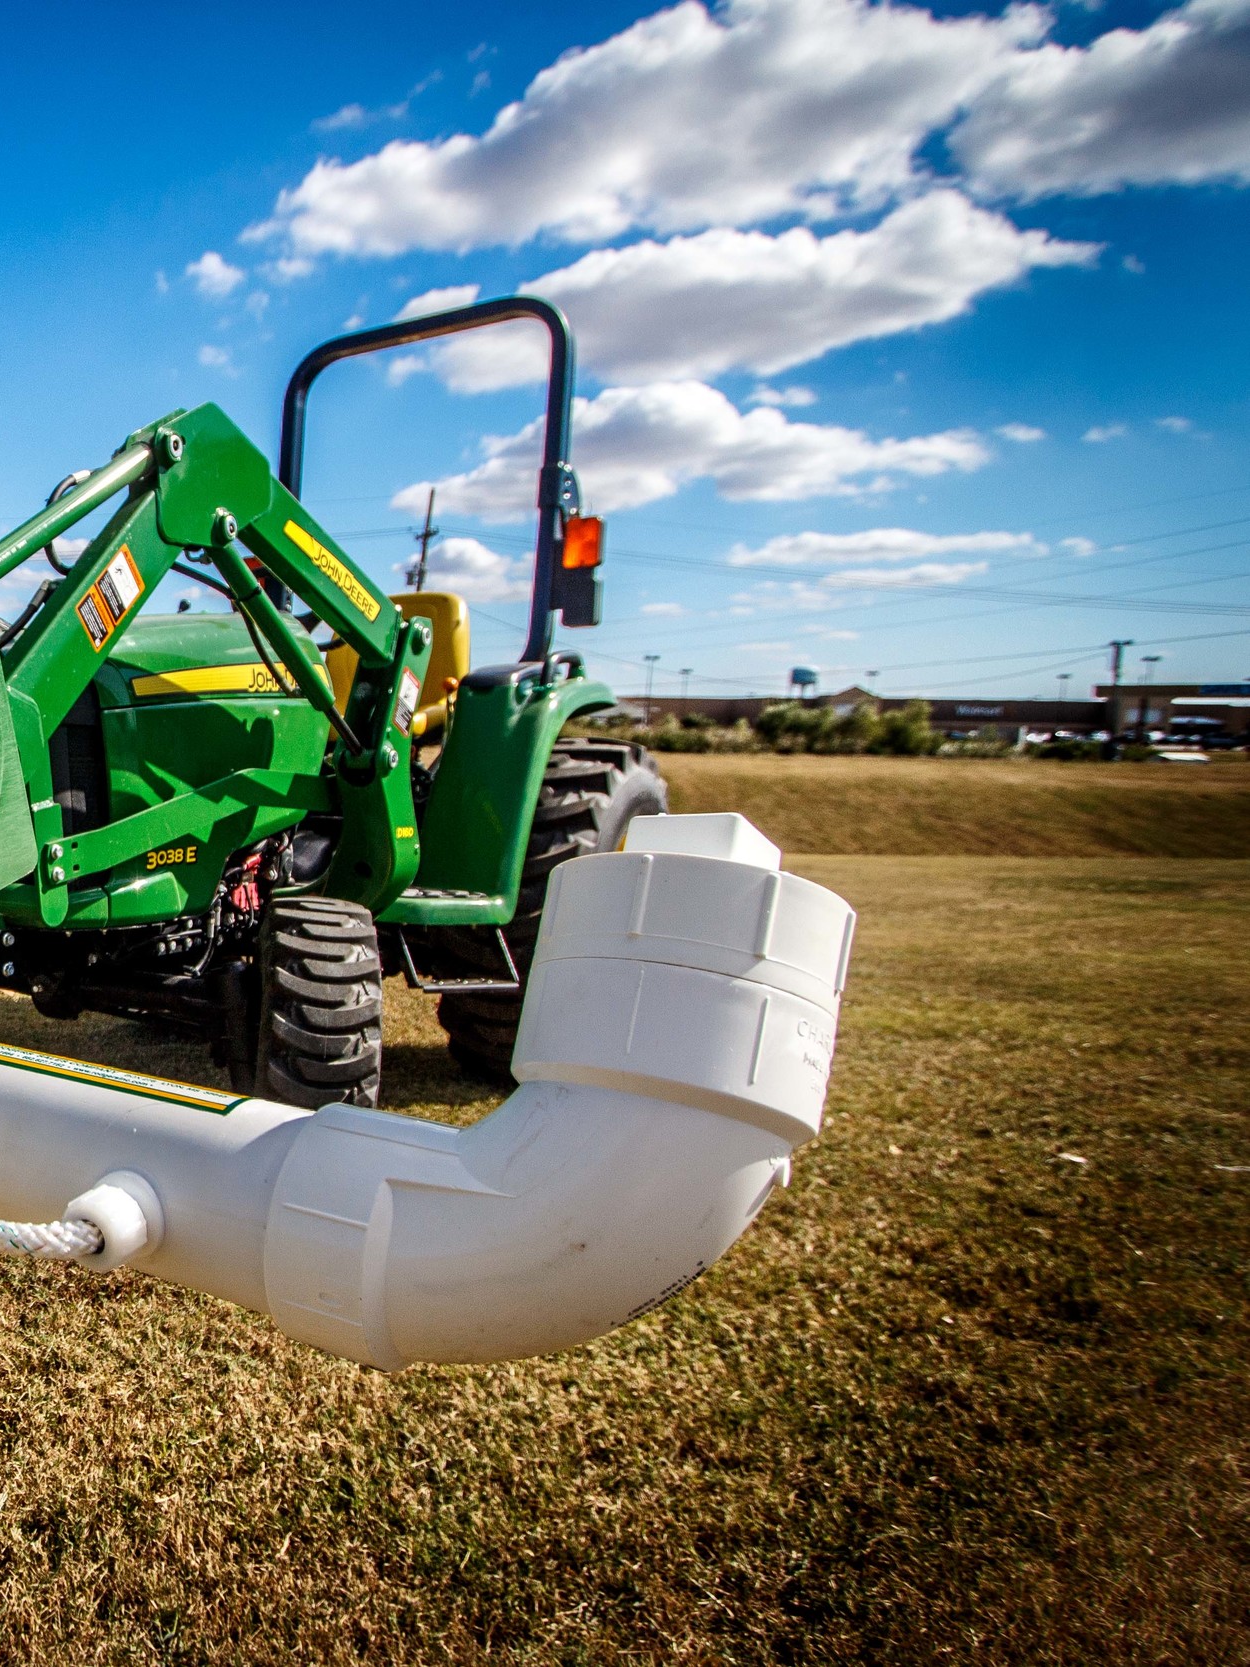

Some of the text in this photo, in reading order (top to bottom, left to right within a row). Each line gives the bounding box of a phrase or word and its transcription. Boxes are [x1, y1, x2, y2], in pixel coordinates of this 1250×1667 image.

[313, 547, 375, 617] JOHN DEERE
[146, 846, 197, 870] 3038 E
